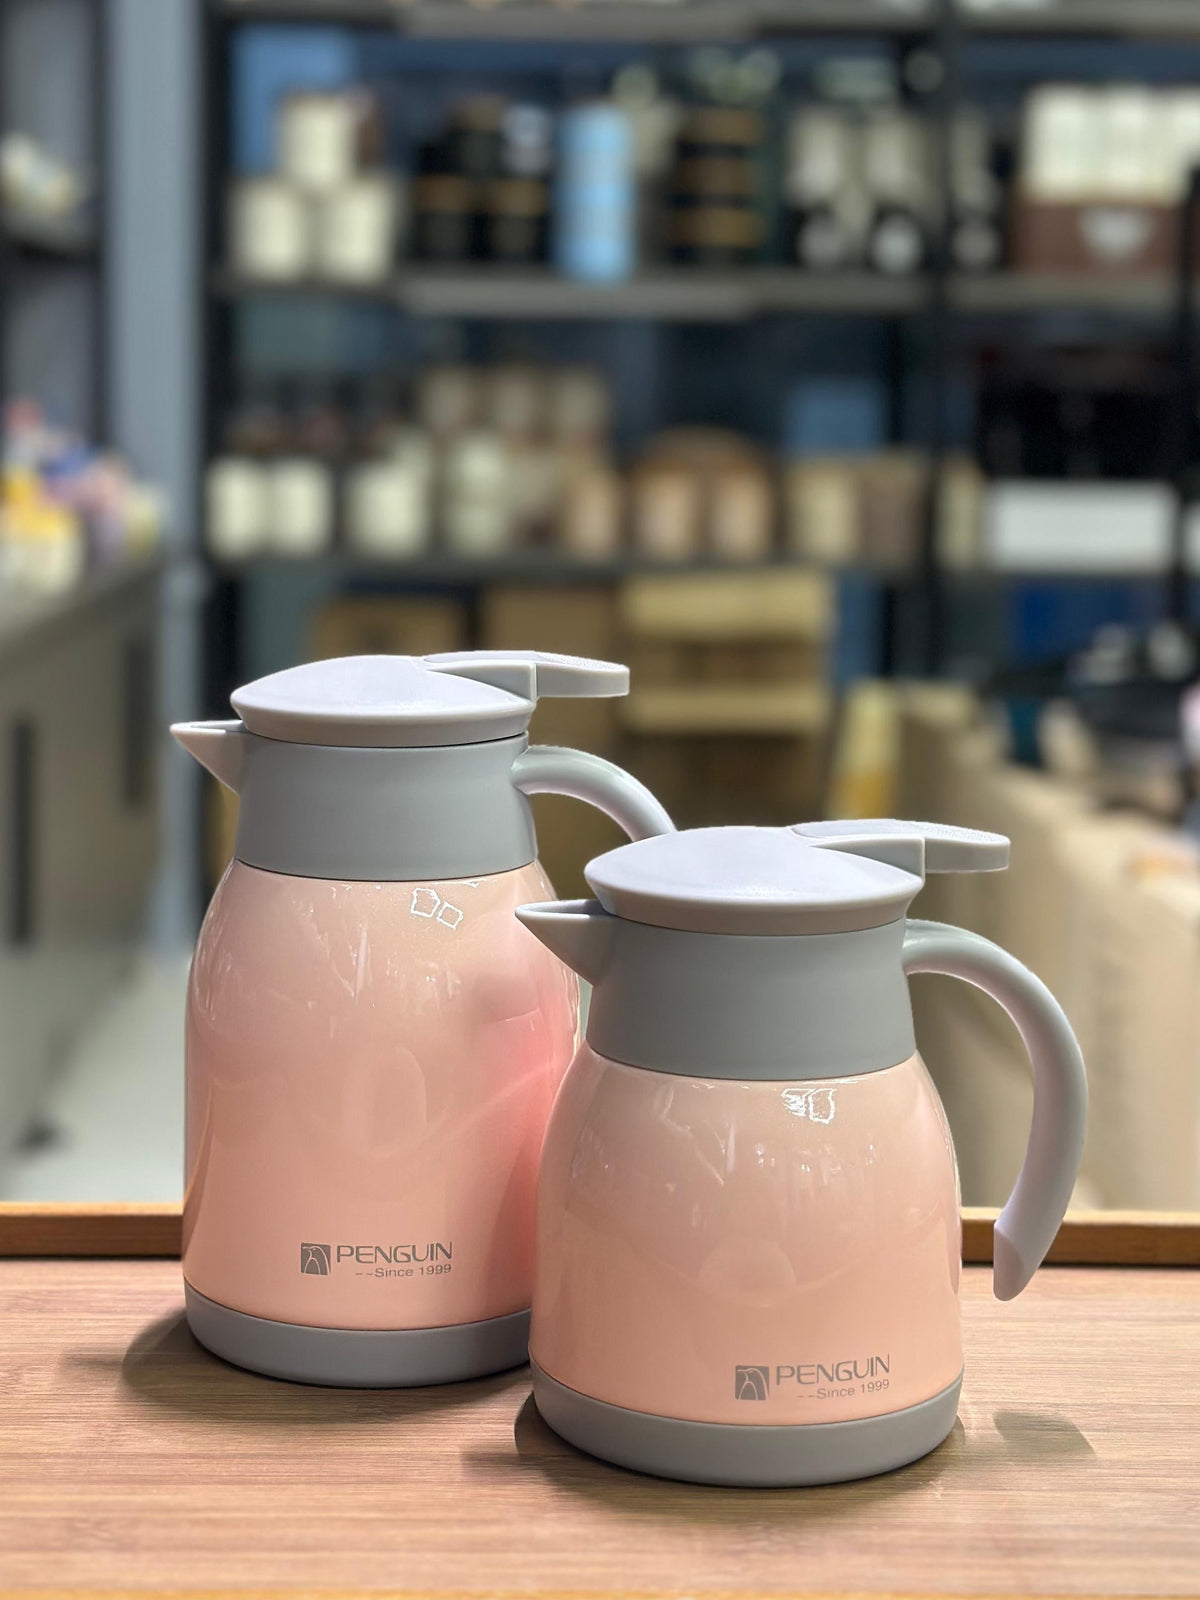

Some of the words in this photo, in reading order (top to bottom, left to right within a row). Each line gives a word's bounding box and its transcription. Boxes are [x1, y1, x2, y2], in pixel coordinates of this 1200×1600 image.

[336, 1242, 453, 1264] PENGUIN
[419, 1264, 452, 1276] 1999
[776, 1354, 890, 1386] PENGUIN
[861, 1379, 890, 1394] 1999
